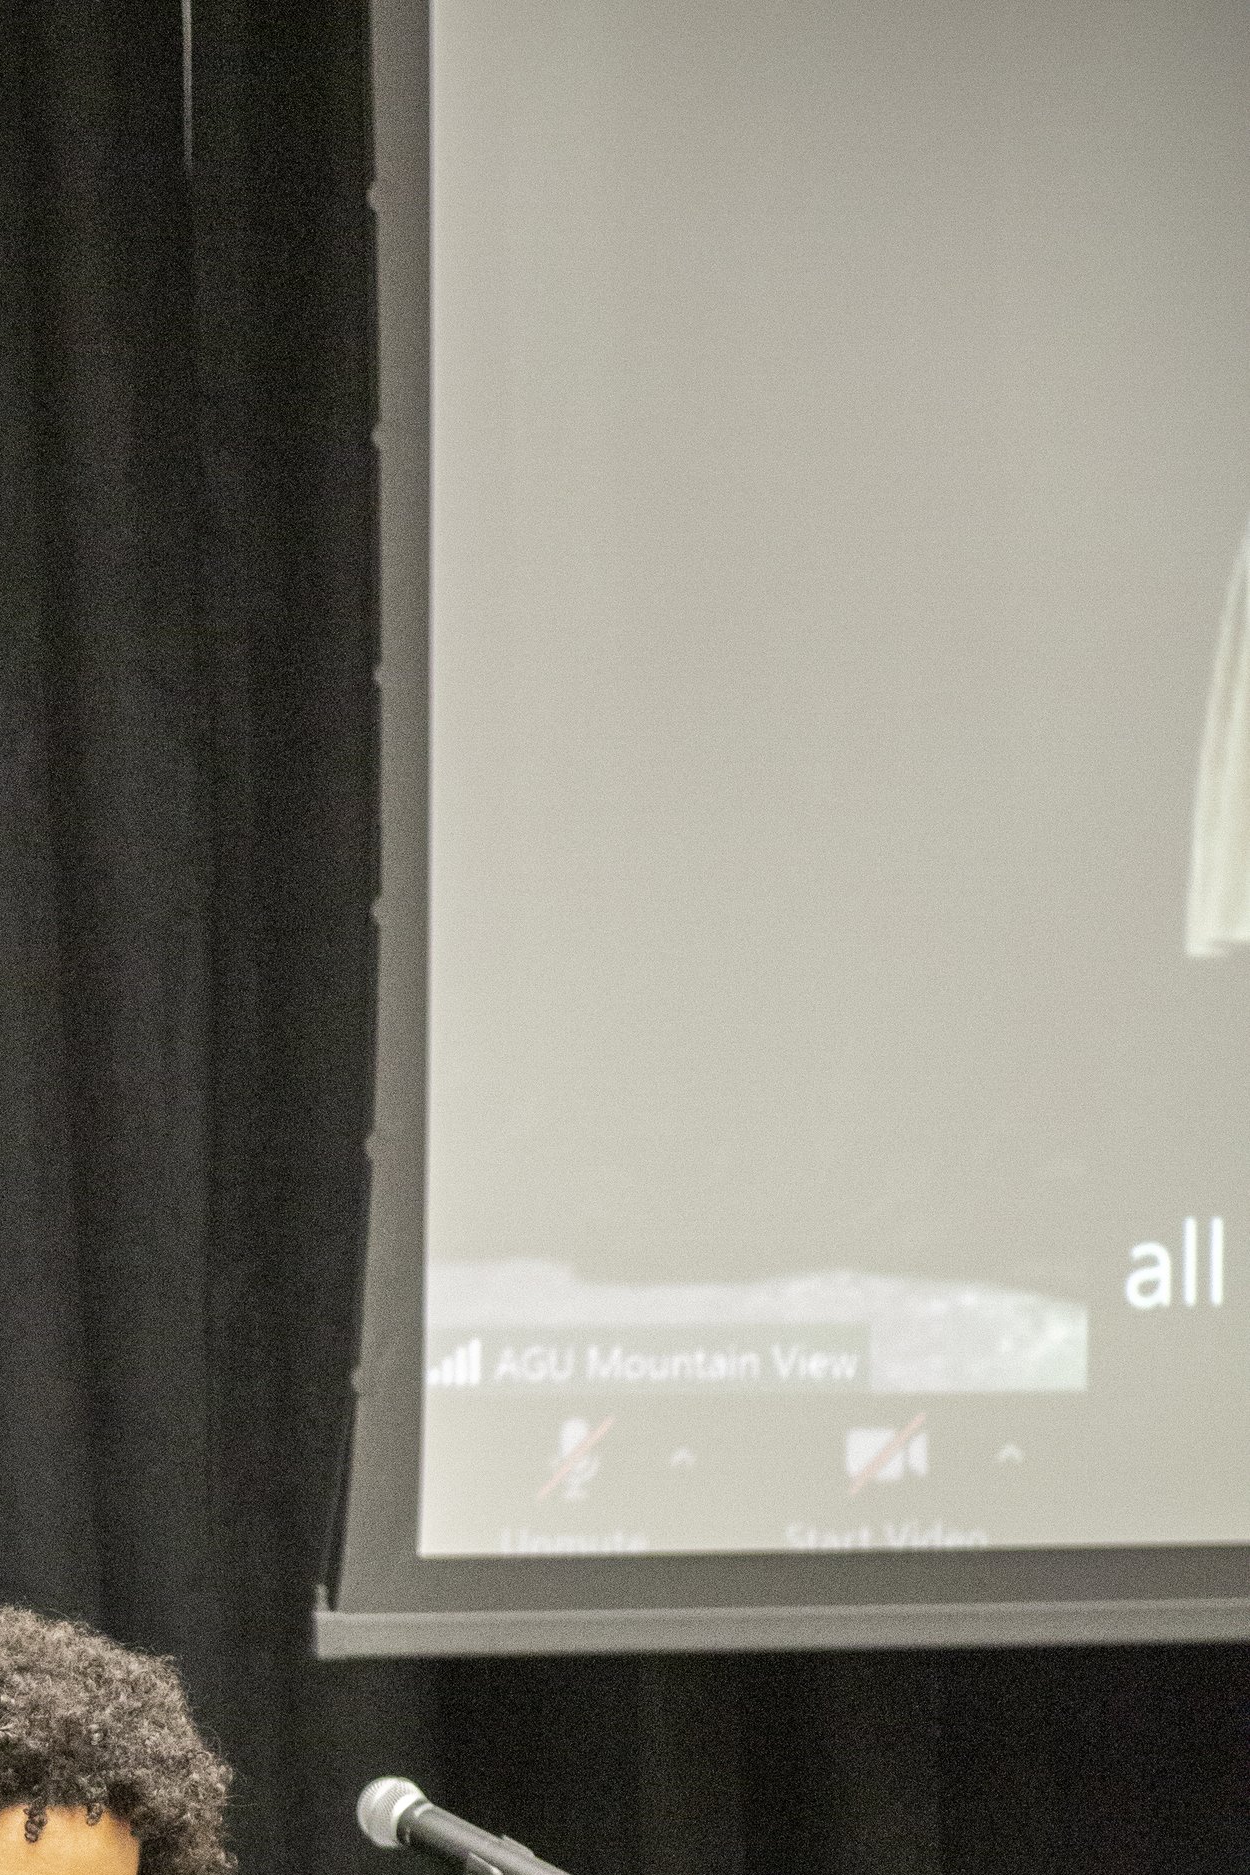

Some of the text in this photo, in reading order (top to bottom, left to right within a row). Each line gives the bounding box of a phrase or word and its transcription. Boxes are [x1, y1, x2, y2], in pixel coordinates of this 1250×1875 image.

[1126, 1216, 1223, 1309] all
[494, 1343, 859, 1382] AGU Mountain View
